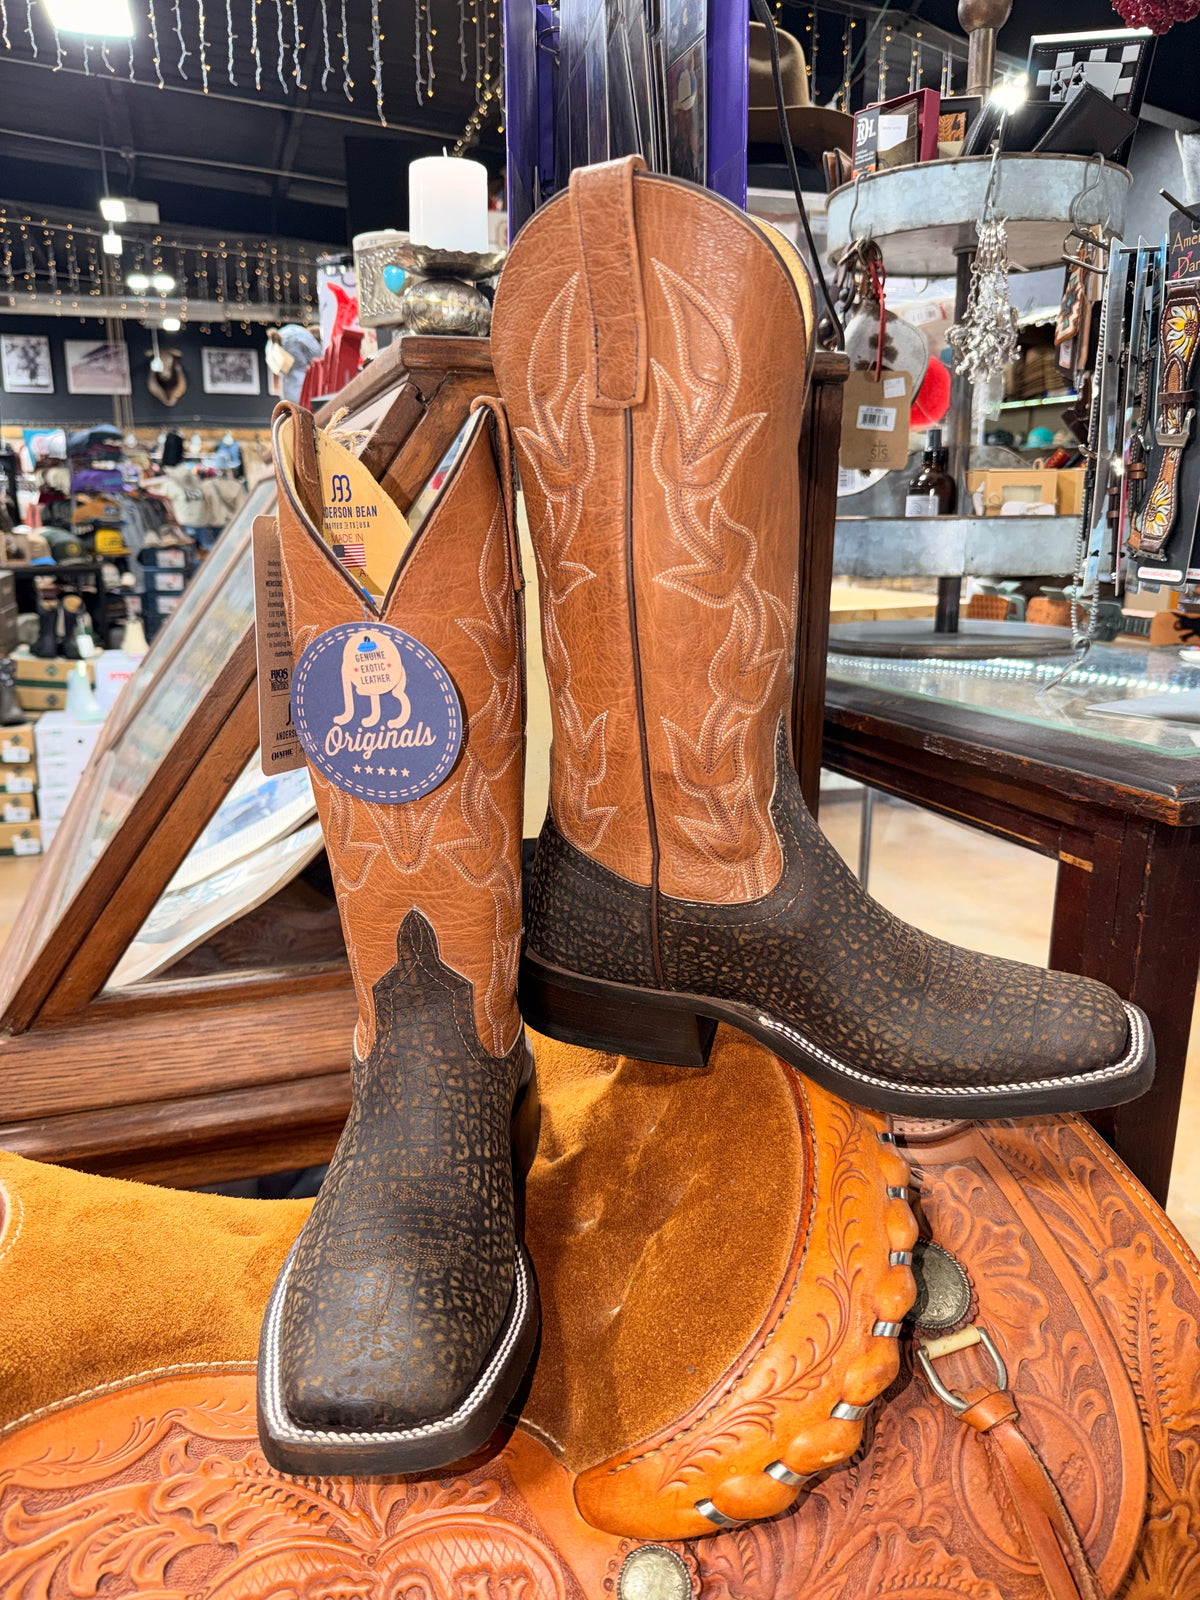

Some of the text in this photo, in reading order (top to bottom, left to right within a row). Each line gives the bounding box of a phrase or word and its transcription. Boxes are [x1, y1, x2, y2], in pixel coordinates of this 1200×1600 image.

[1075, 63, 1085, 73] A
[1054, 71, 1062, 81] J
[356, 505, 378, 518] BEAN
[331, 533, 364, 544] MADE IN
[355, 651, 386, 662] GENUINE
[360, 663, 386, 674] EXOTIC
[360, 674, 391, 685] LEATHER
[325, 721, 437, 760] Originals
